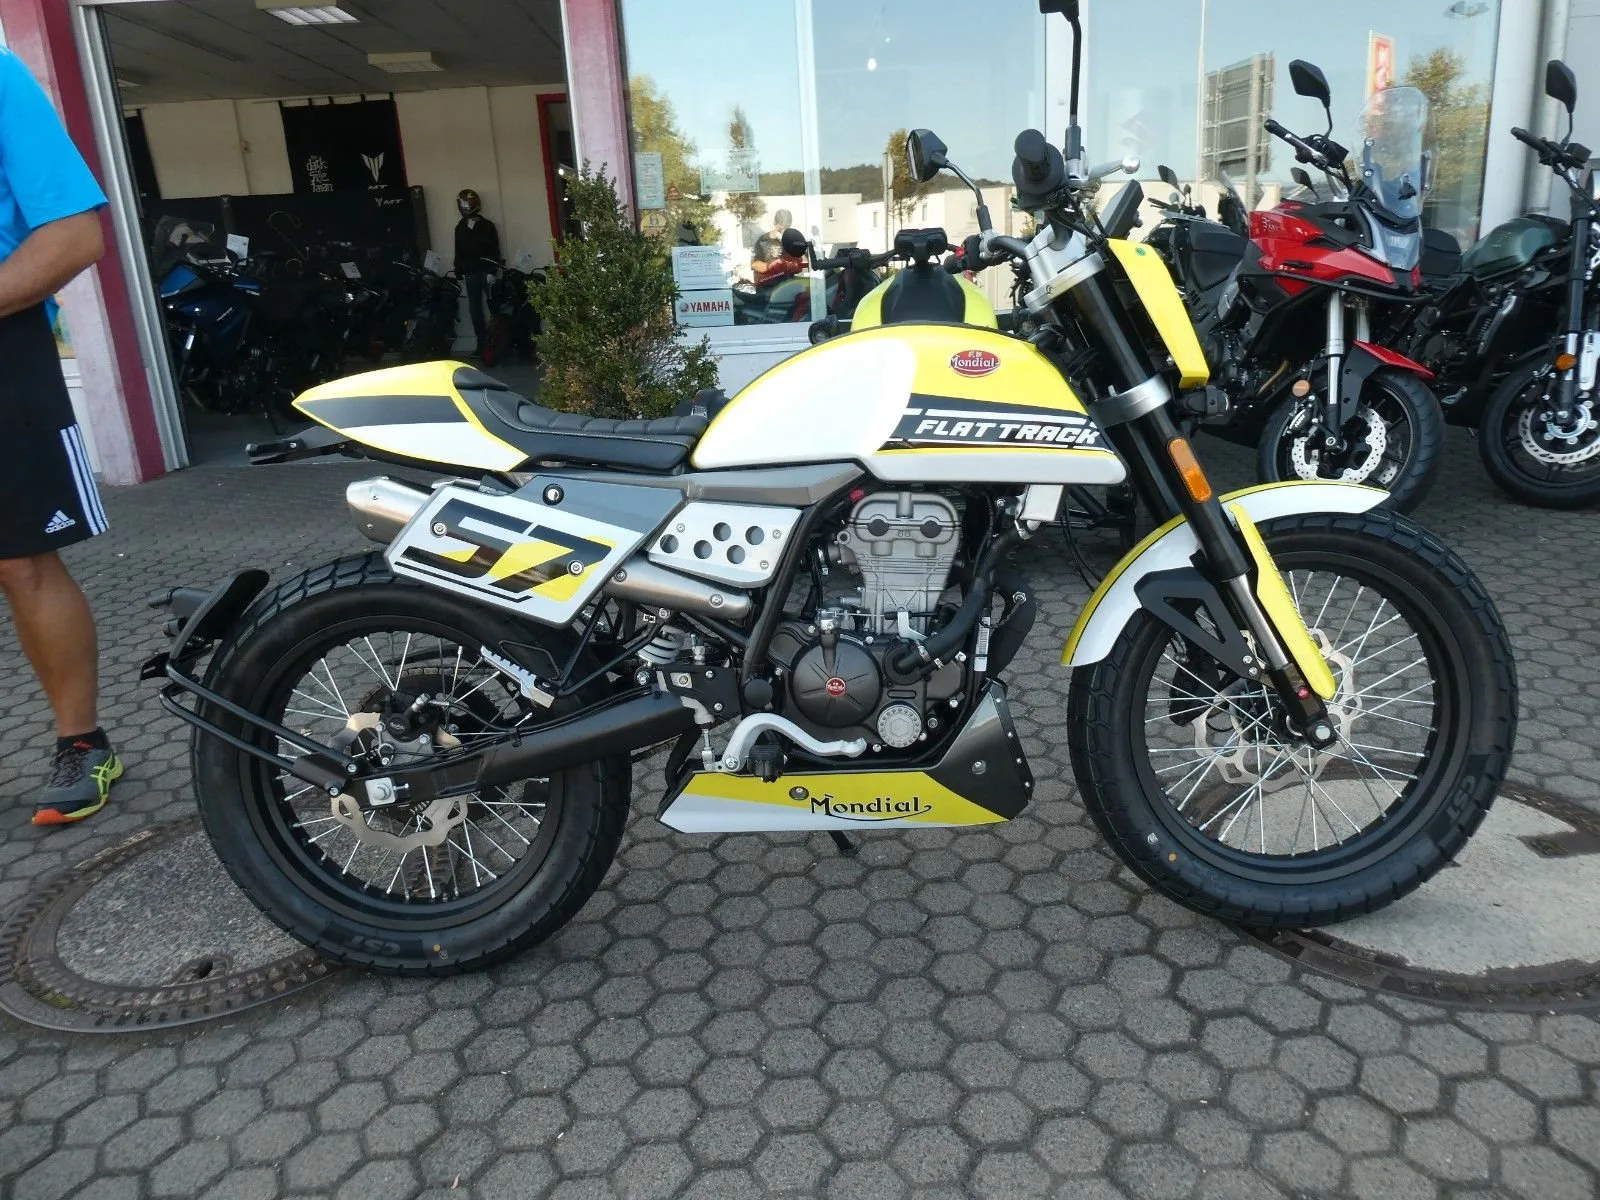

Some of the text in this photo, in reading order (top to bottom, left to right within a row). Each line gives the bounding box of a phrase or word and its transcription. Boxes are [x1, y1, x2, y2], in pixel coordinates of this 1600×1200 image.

[690, 301, 731, 312] YAMAHA
[950, 355, 1000, 372] Mondial
[915, 419, 1100, 445] FLAT TRACK
[45, 519, 76, 534] adidas
[810, 794, 932, 822] Mondial
